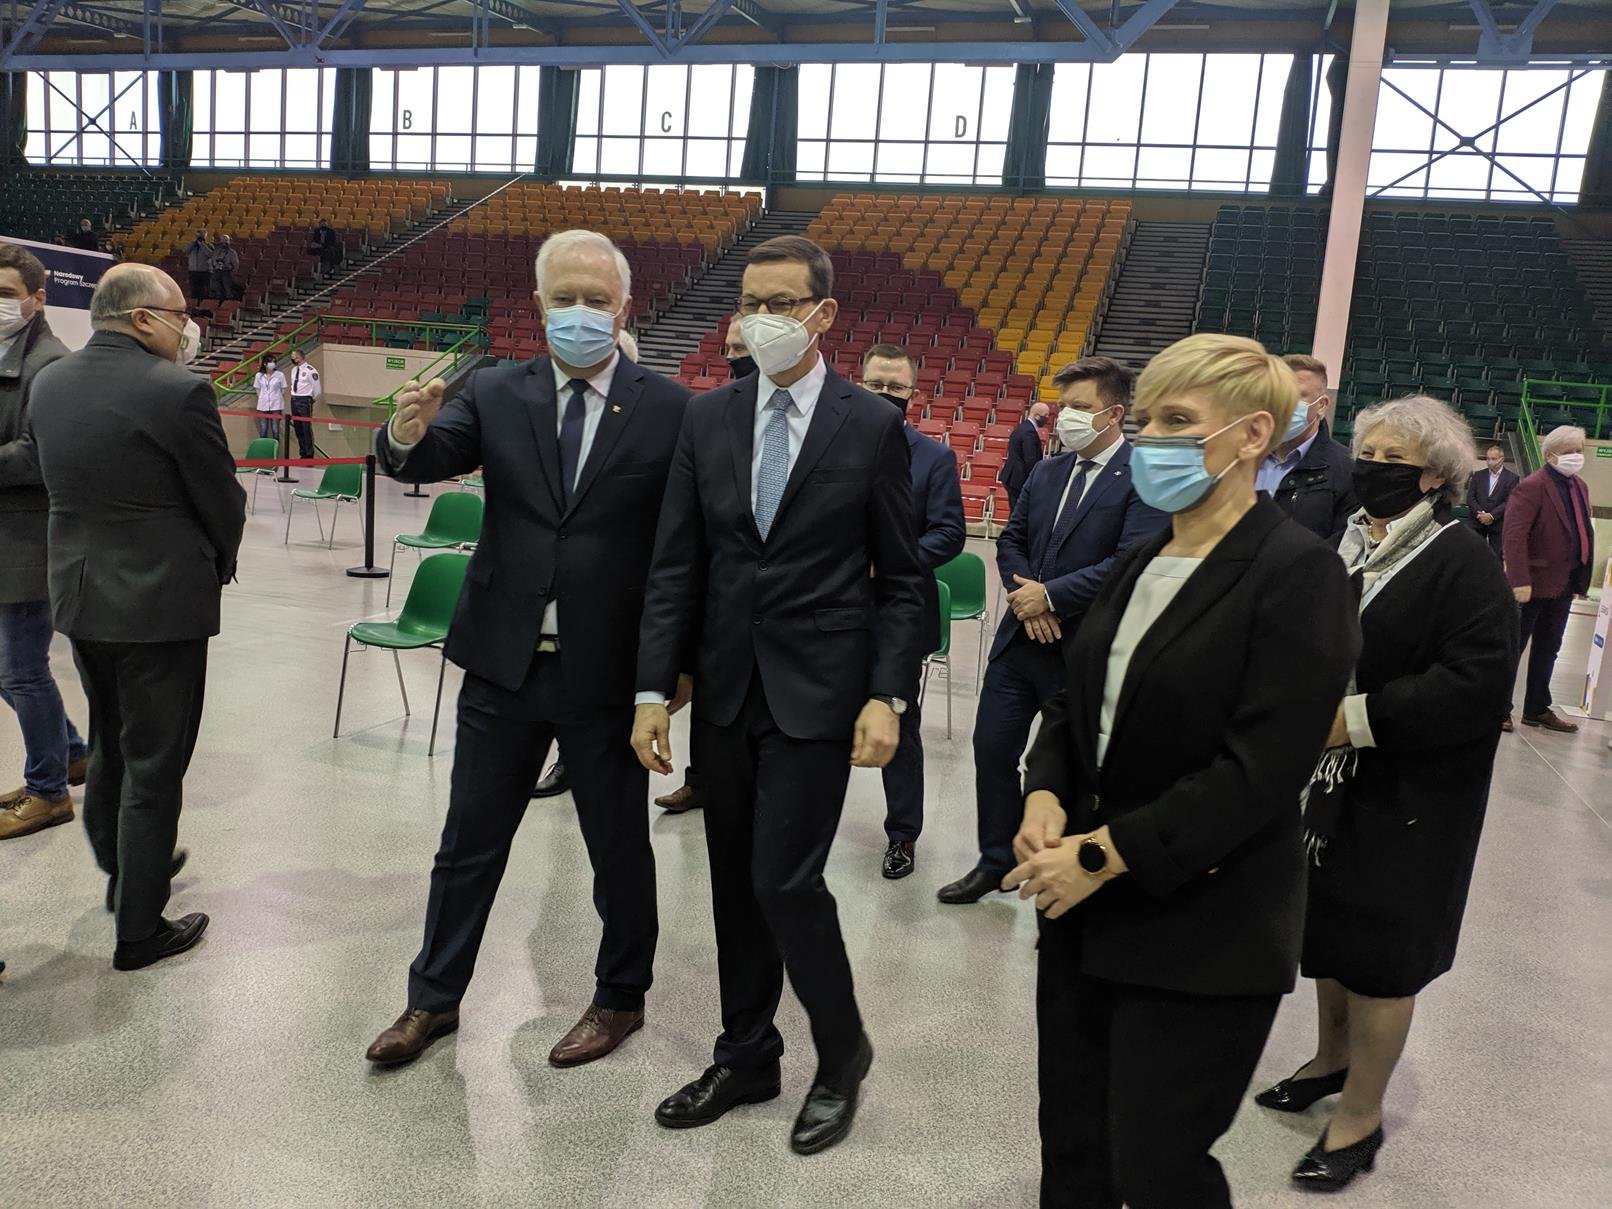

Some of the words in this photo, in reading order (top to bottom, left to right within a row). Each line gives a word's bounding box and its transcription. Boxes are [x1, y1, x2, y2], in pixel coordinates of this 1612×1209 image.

[129, 111, 138, 130] A
[402, 110, 413, 130] B
[661, 111, 672, 133] C
[954, 115, 968, 138] D
[54, 270, 84, 283] Narodowy
[54, 277, 79, 286] Program
